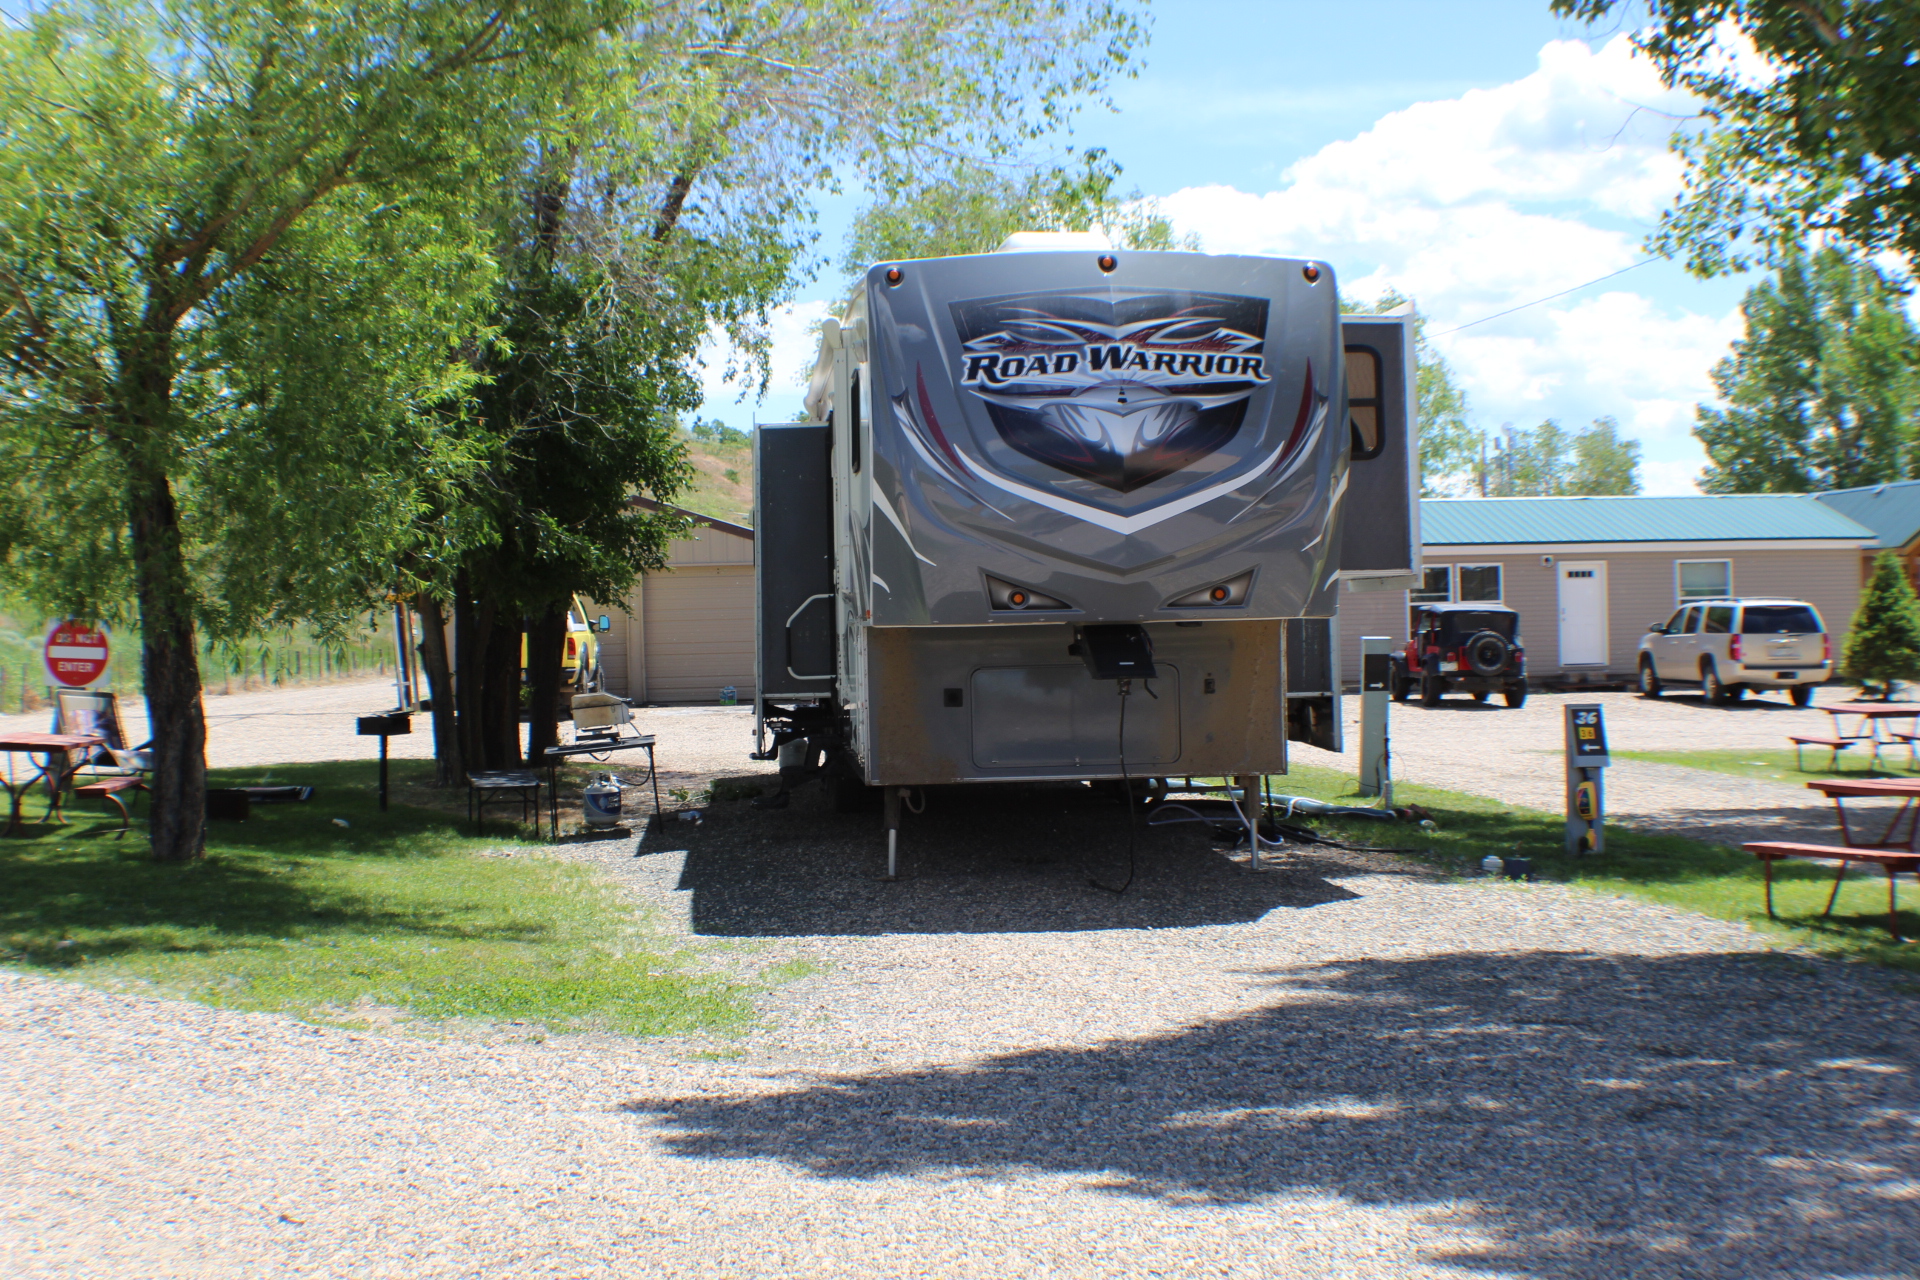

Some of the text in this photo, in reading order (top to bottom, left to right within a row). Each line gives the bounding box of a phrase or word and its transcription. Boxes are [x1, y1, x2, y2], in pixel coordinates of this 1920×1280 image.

[962, 345, 1272, 385] ROAD WARRIOR
[75, 633, 99, 644] NOT
[58, 661, 95, 672] ENTER
[1574, 711, 1598, 724] 36
